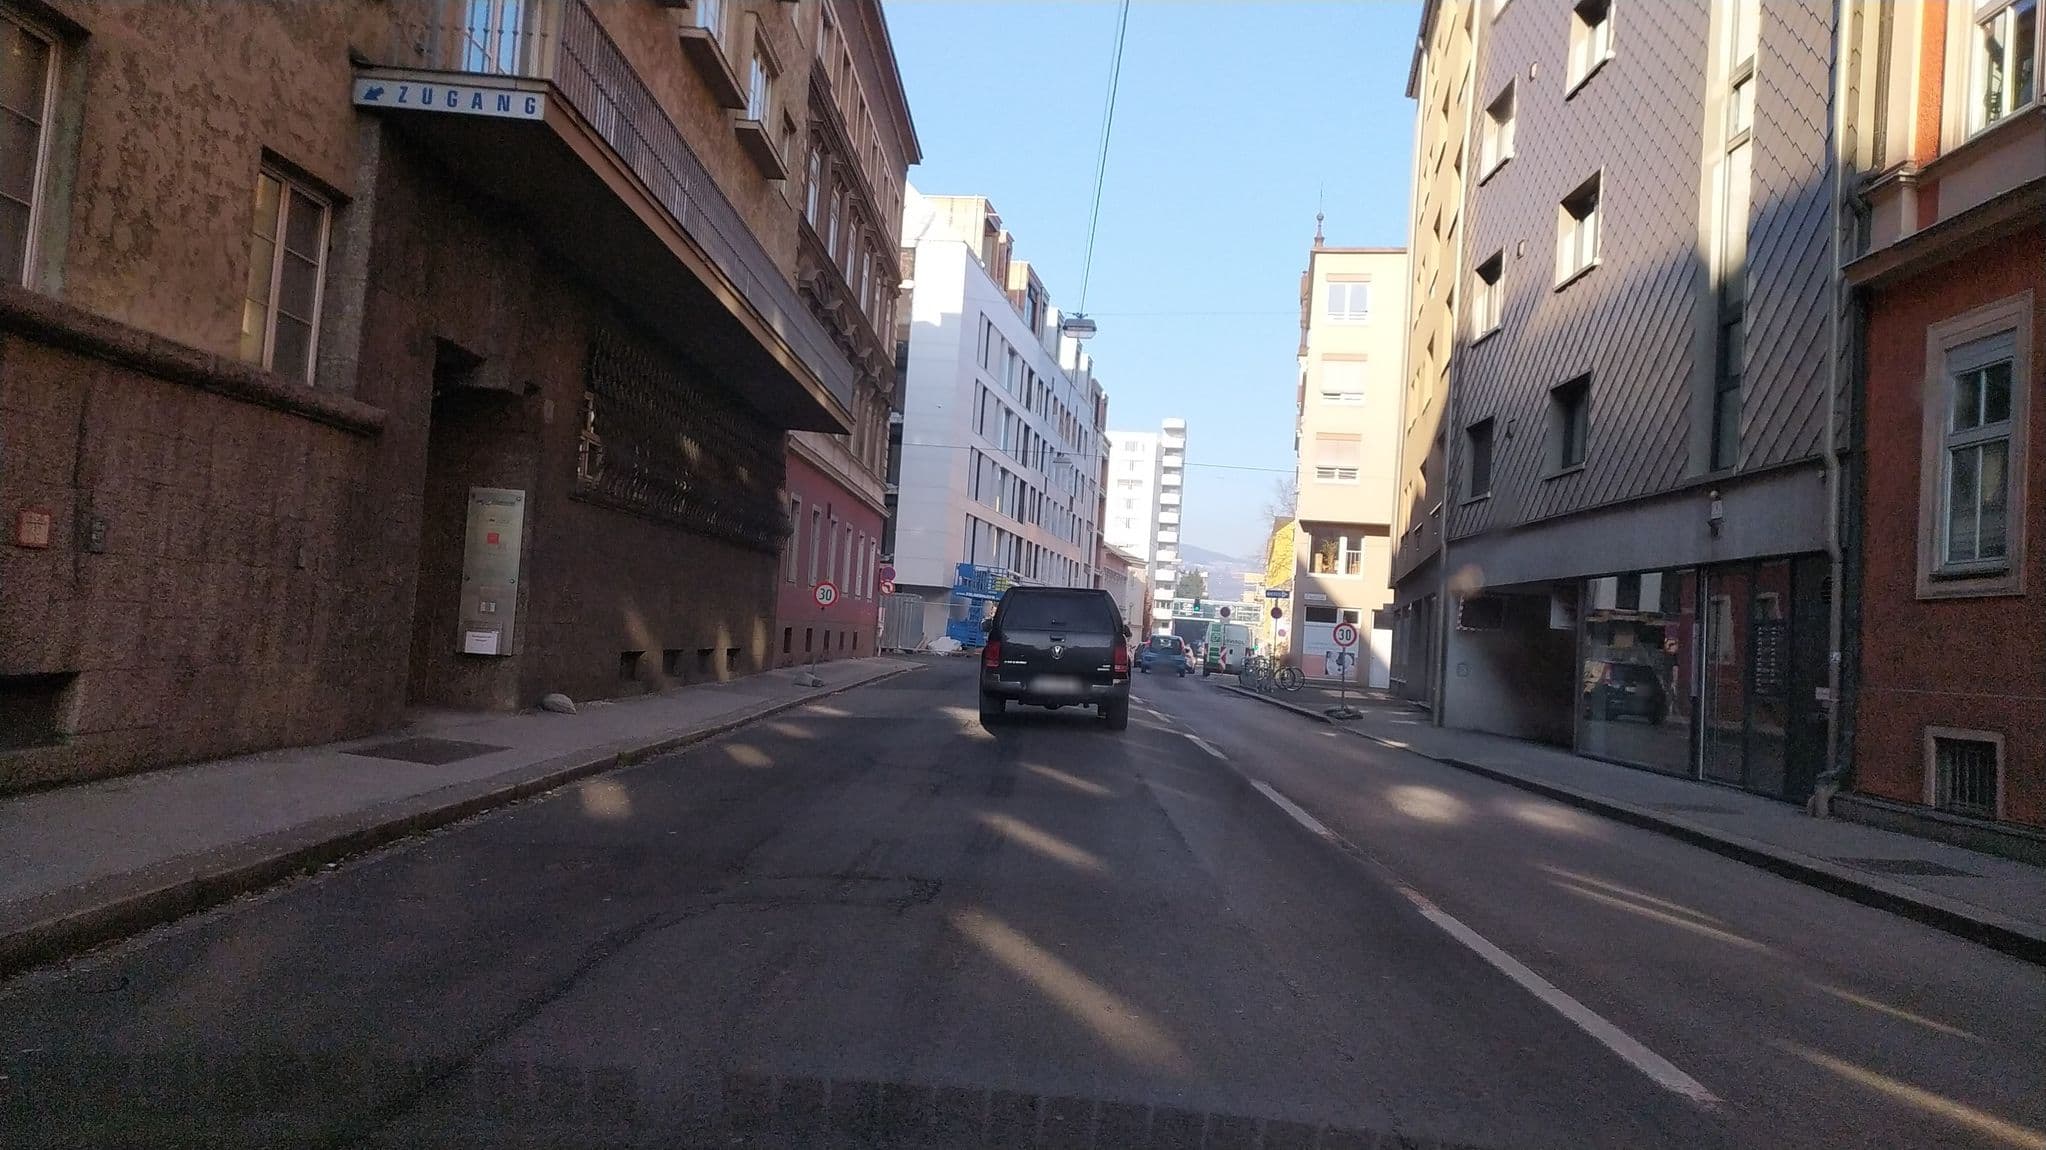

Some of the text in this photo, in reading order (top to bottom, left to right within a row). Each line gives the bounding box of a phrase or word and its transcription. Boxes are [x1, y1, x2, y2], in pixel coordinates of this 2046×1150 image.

[398, 86, 536, 114] ZUGANG
[819, 588, 832, 601] 30
[1338, 629, 1352, 641] 30
